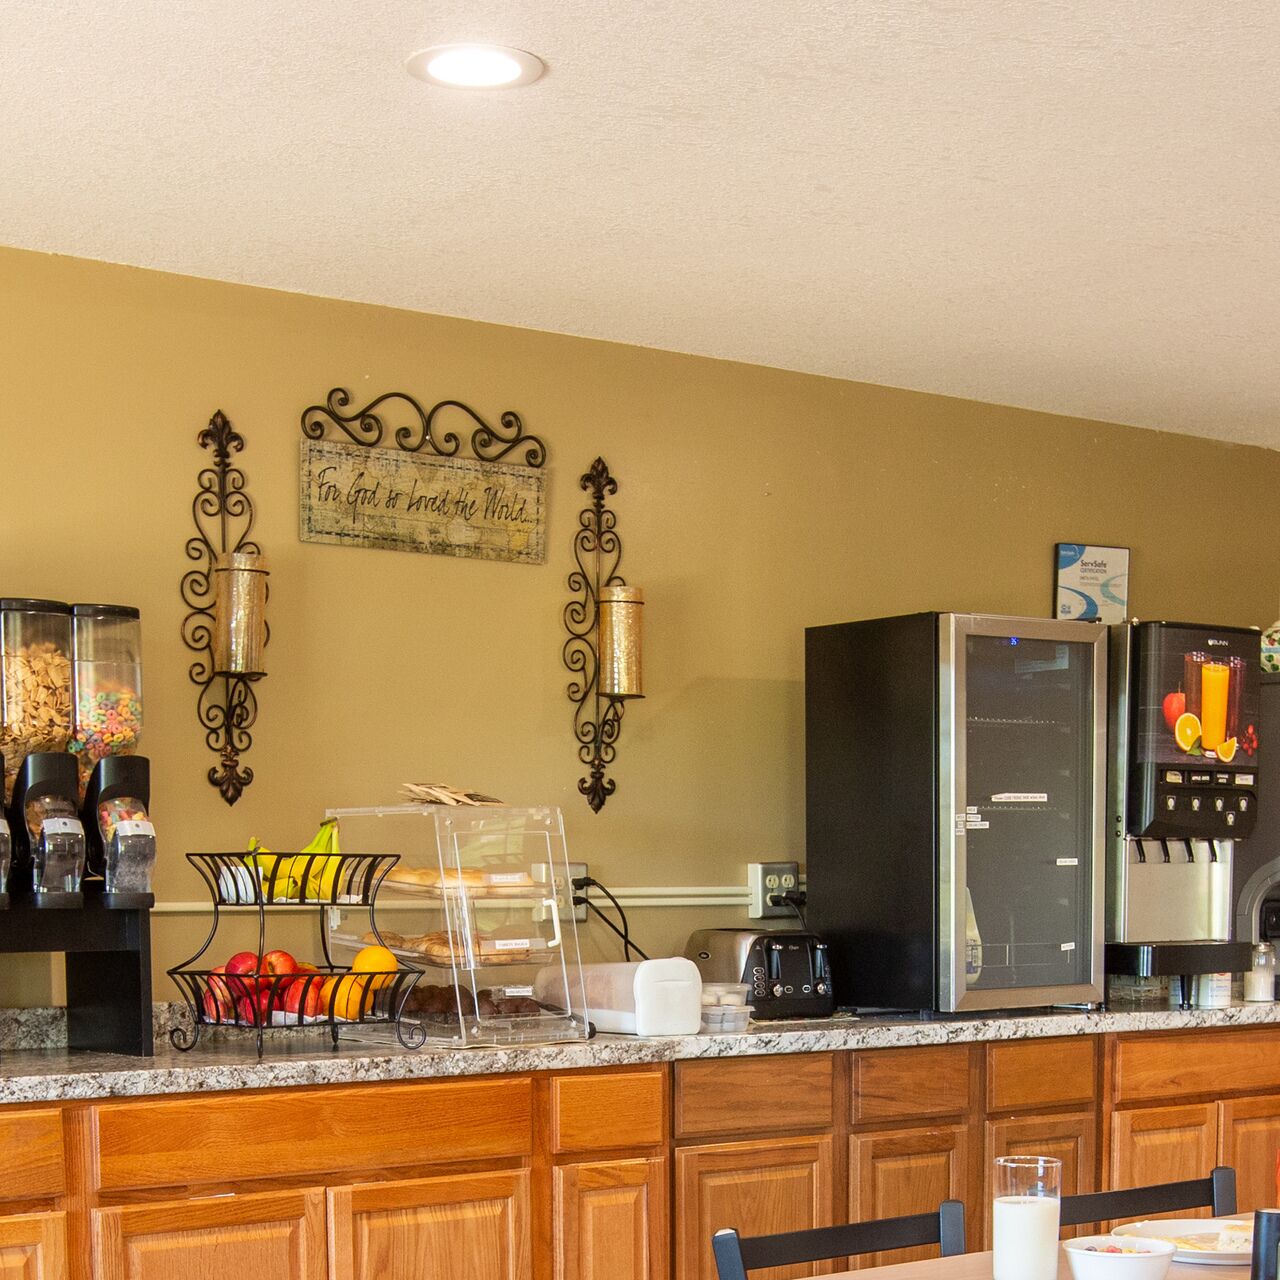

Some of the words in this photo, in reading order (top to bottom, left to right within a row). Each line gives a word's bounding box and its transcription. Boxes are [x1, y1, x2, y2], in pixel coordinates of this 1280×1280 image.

[317, 466, 341, 503] For
[347, 471, 379, 524] God
[385, 491, 404, 509] so
[407, 478, 450, 516] Loved
[454, 487, 479, 522] the
